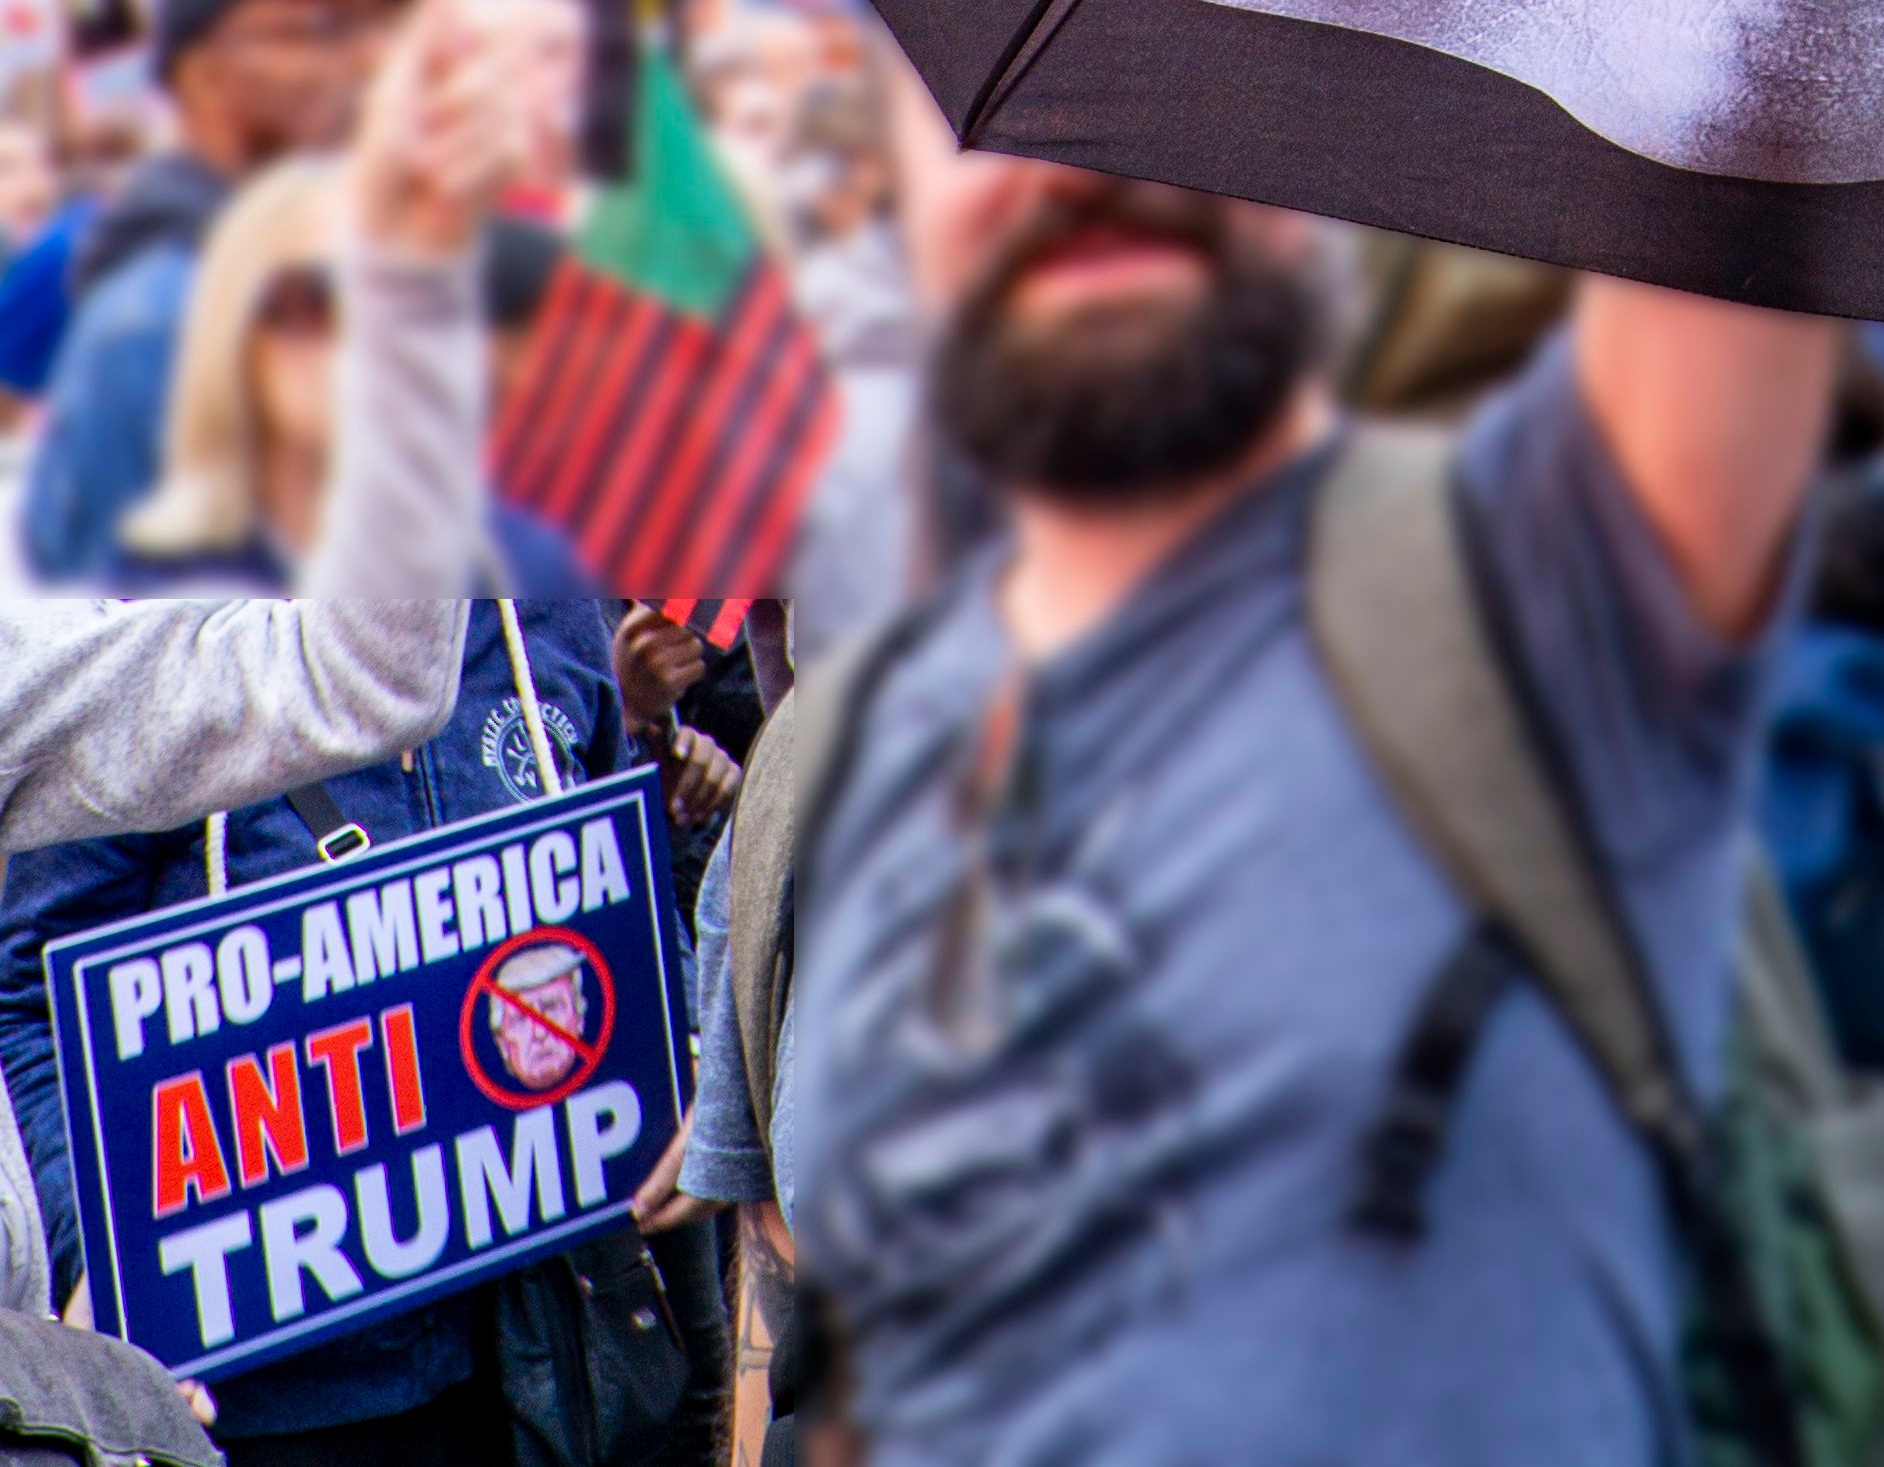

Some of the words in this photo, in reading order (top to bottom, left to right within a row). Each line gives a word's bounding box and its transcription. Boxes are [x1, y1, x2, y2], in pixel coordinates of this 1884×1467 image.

[109, 817, 630, 1061] PRO-AMERICA
[152, 1003, 429, 1219] ANTI
[158, 1077, 643, 1350] TRUMP
